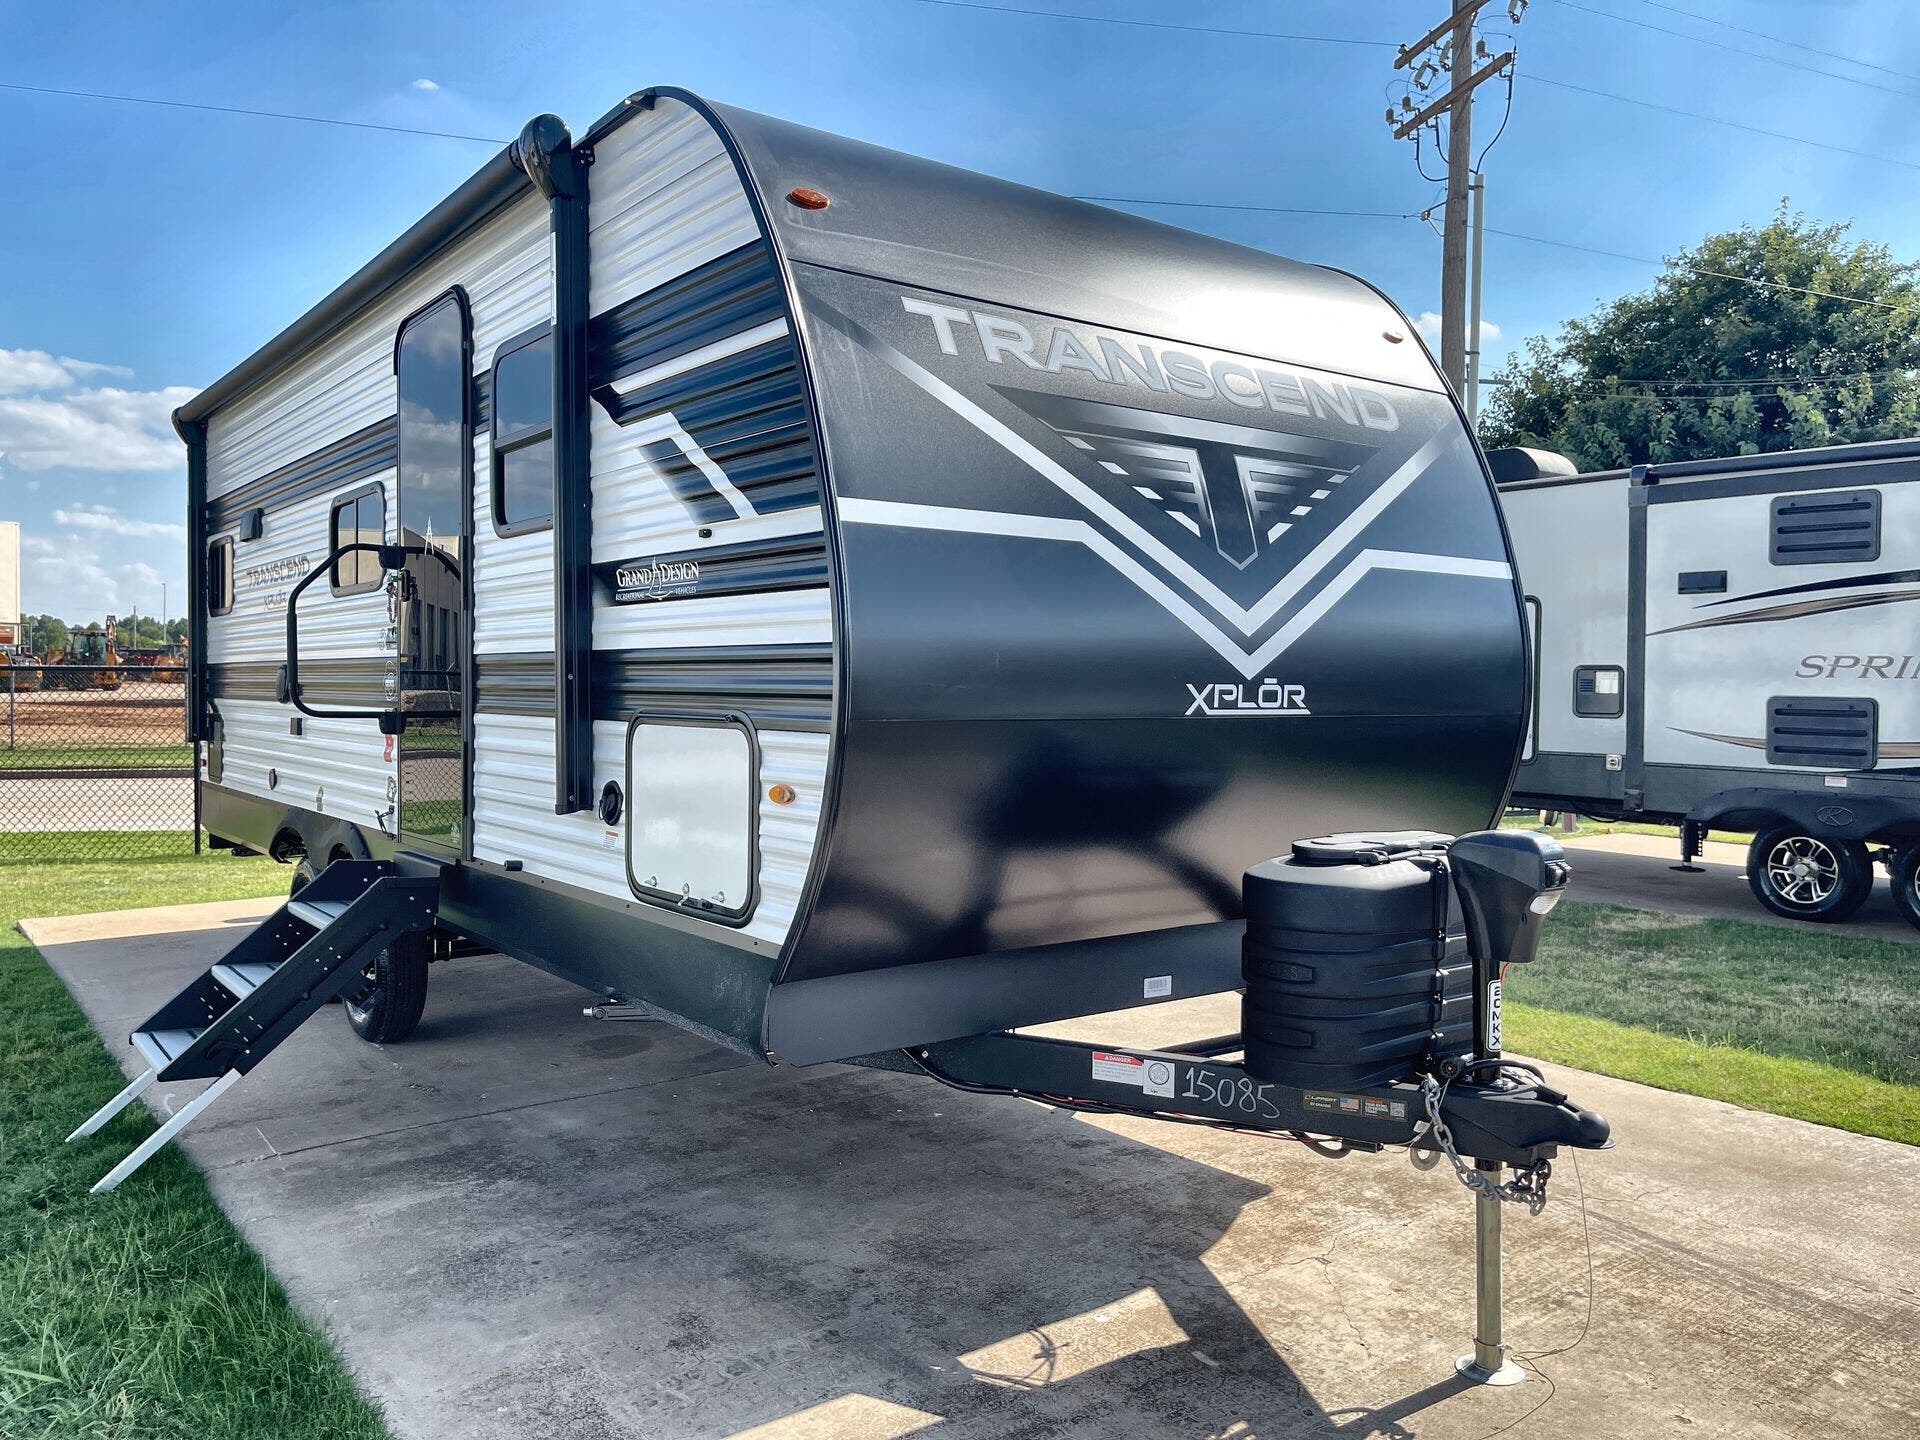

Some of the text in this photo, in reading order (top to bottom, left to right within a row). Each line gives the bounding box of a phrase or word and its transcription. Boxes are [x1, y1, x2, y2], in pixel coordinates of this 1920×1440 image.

[901, 296, 1400, 432] TRANSCEND
[246, 556, 311, 588] TRANSCEND
[616, 562, 699, 587] GRAND DESIGN
[1181, 1066, 1280, 1119] 15085
